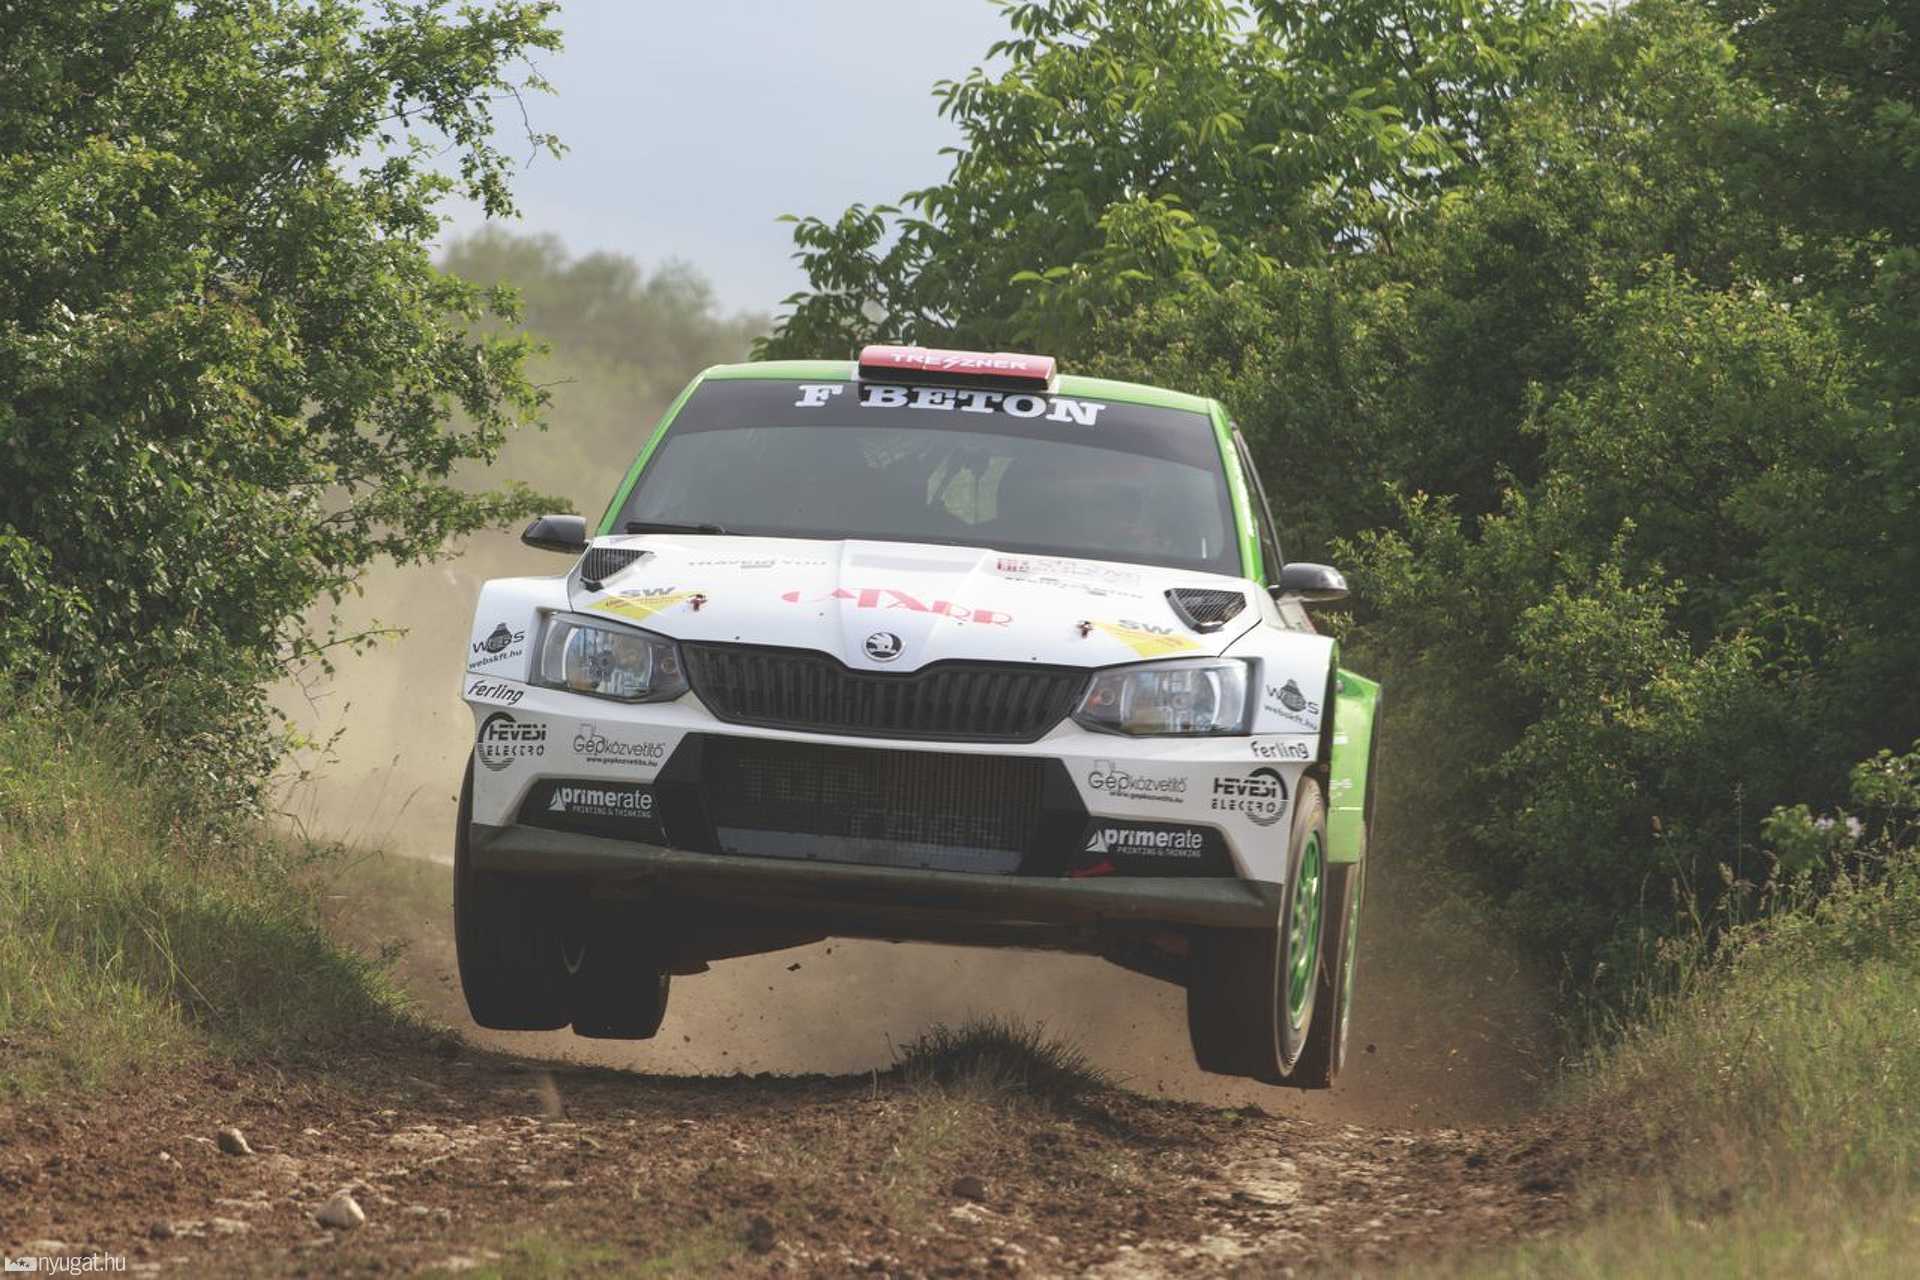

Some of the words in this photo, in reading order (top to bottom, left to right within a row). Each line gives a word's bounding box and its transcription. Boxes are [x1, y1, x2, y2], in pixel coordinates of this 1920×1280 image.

[795, 384, 844, 408] F
[860, 384, 1106, 426] BETON
[468, 680, 524, 706] Ferling
[1250, 740, 1310, 760] Ferling
[561, 786, 653, 810] primerate
[1104, 828, 1203, 849] primerate
